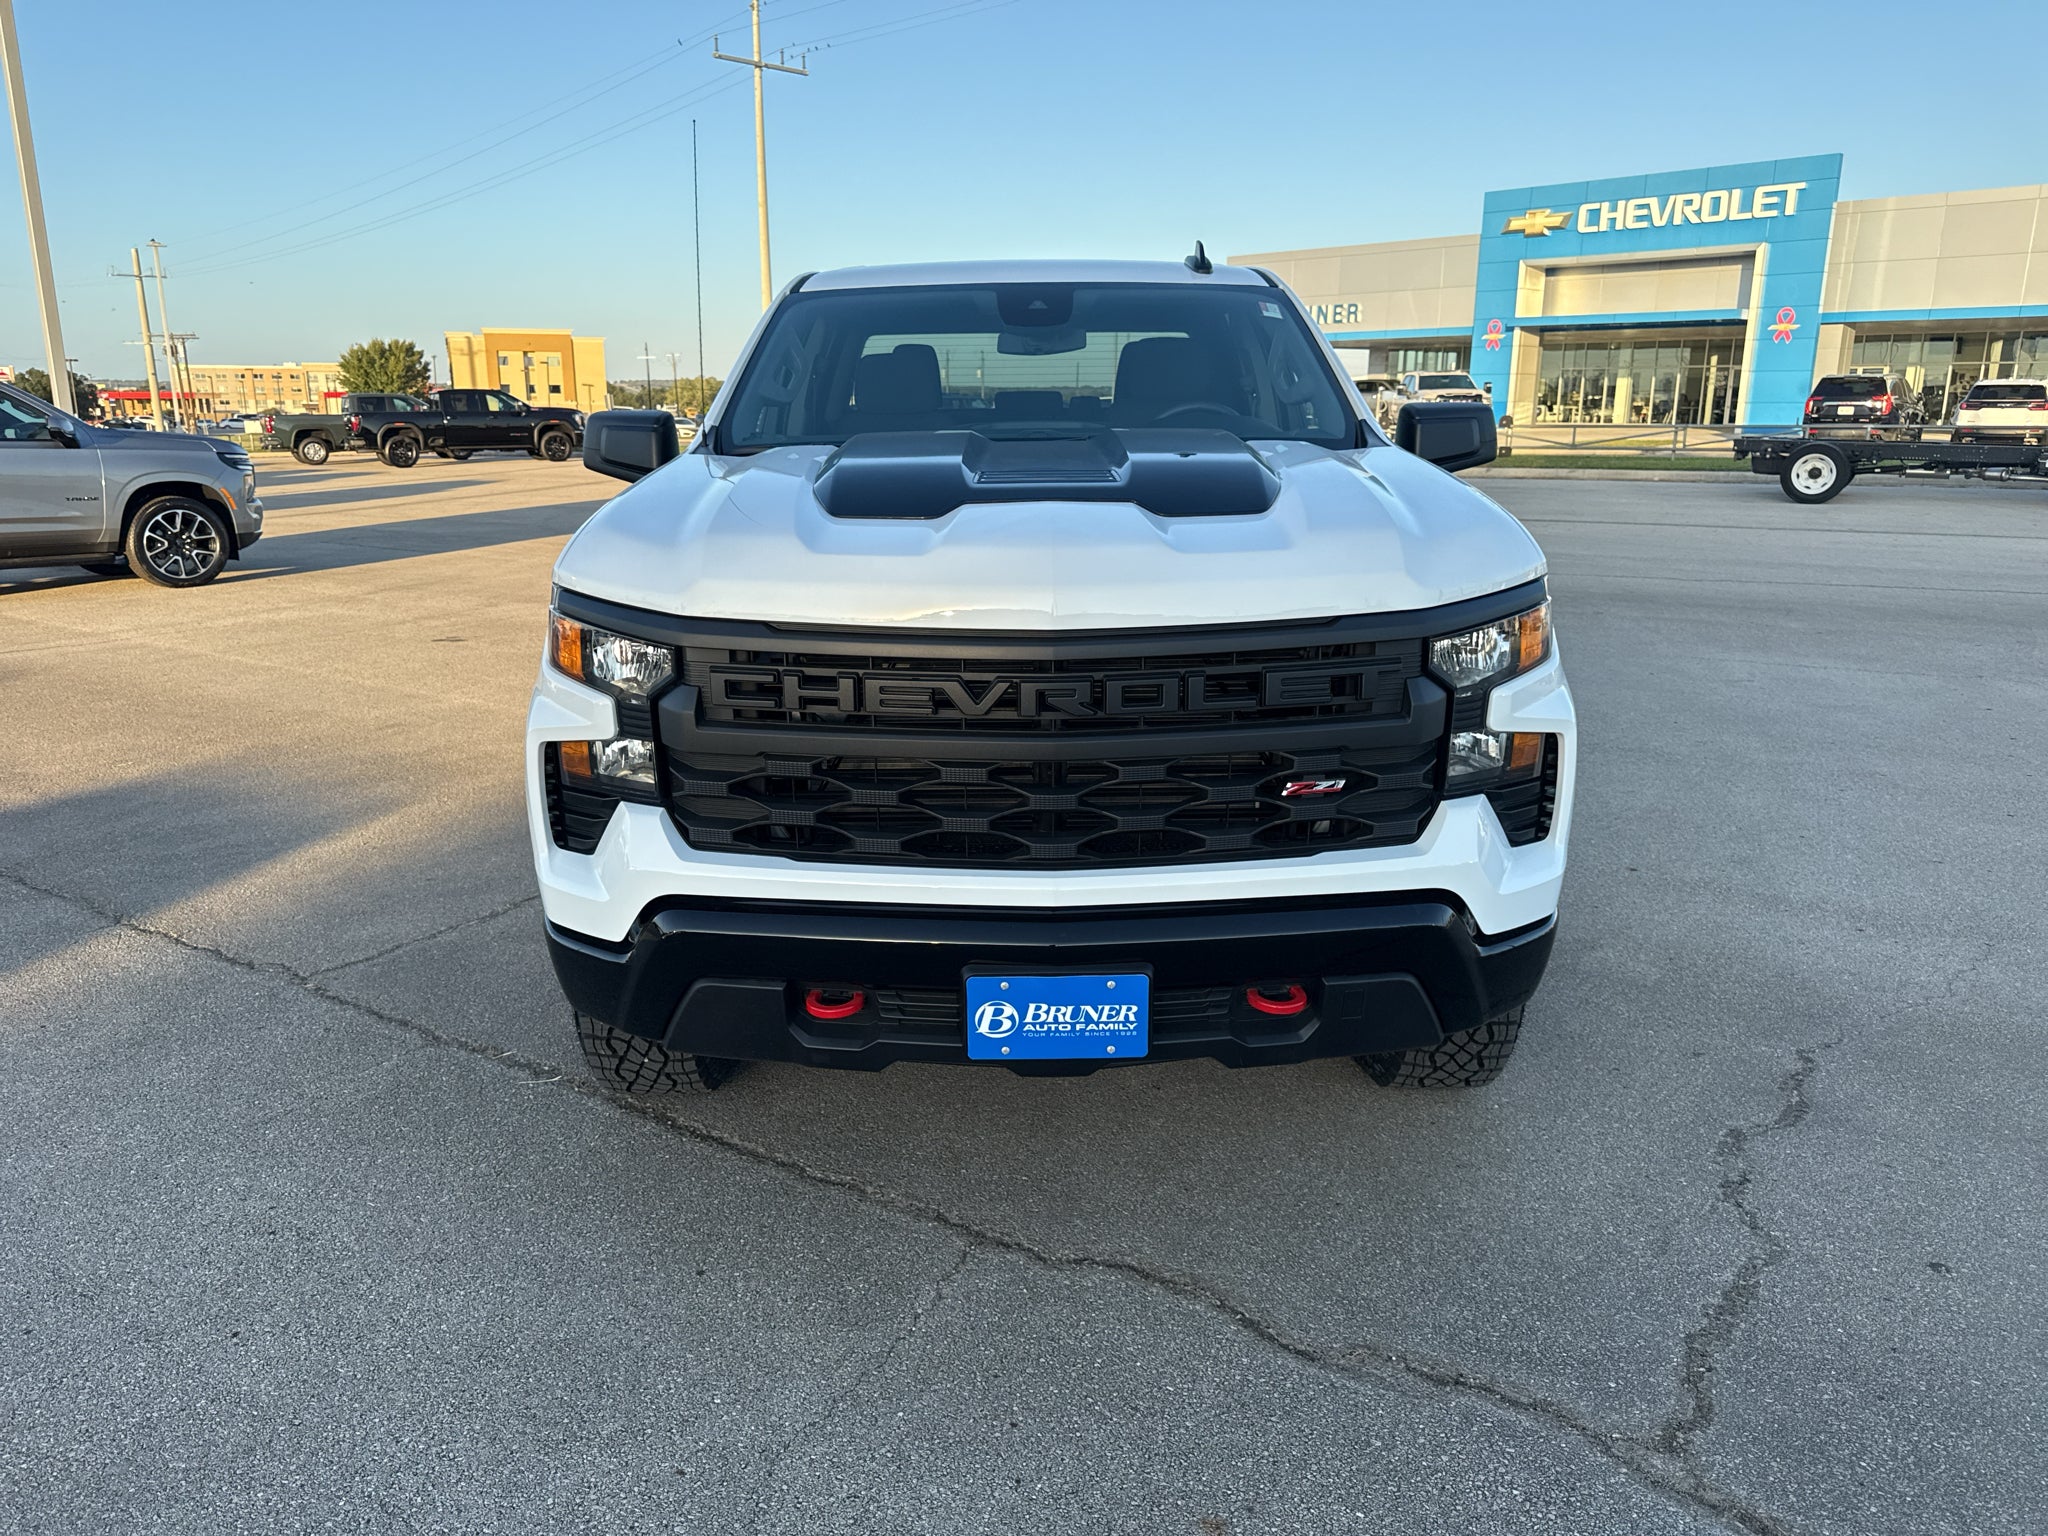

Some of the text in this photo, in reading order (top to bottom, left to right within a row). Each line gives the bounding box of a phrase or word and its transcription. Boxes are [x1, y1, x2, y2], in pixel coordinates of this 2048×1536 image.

[1577, 182, 1806, 234] CHEVROLET
[1308, 303, 1360, 325] NER
[709, 663, 1401, 718] CHEVROLET
[1281, 780, 1346, 796] Z71
[975, 1004, 1015, 1034] B
[1023, 1003, 1139, 1023] BRUNER
[1023, 1022, 1139, 1032] AUTO FAMILY
